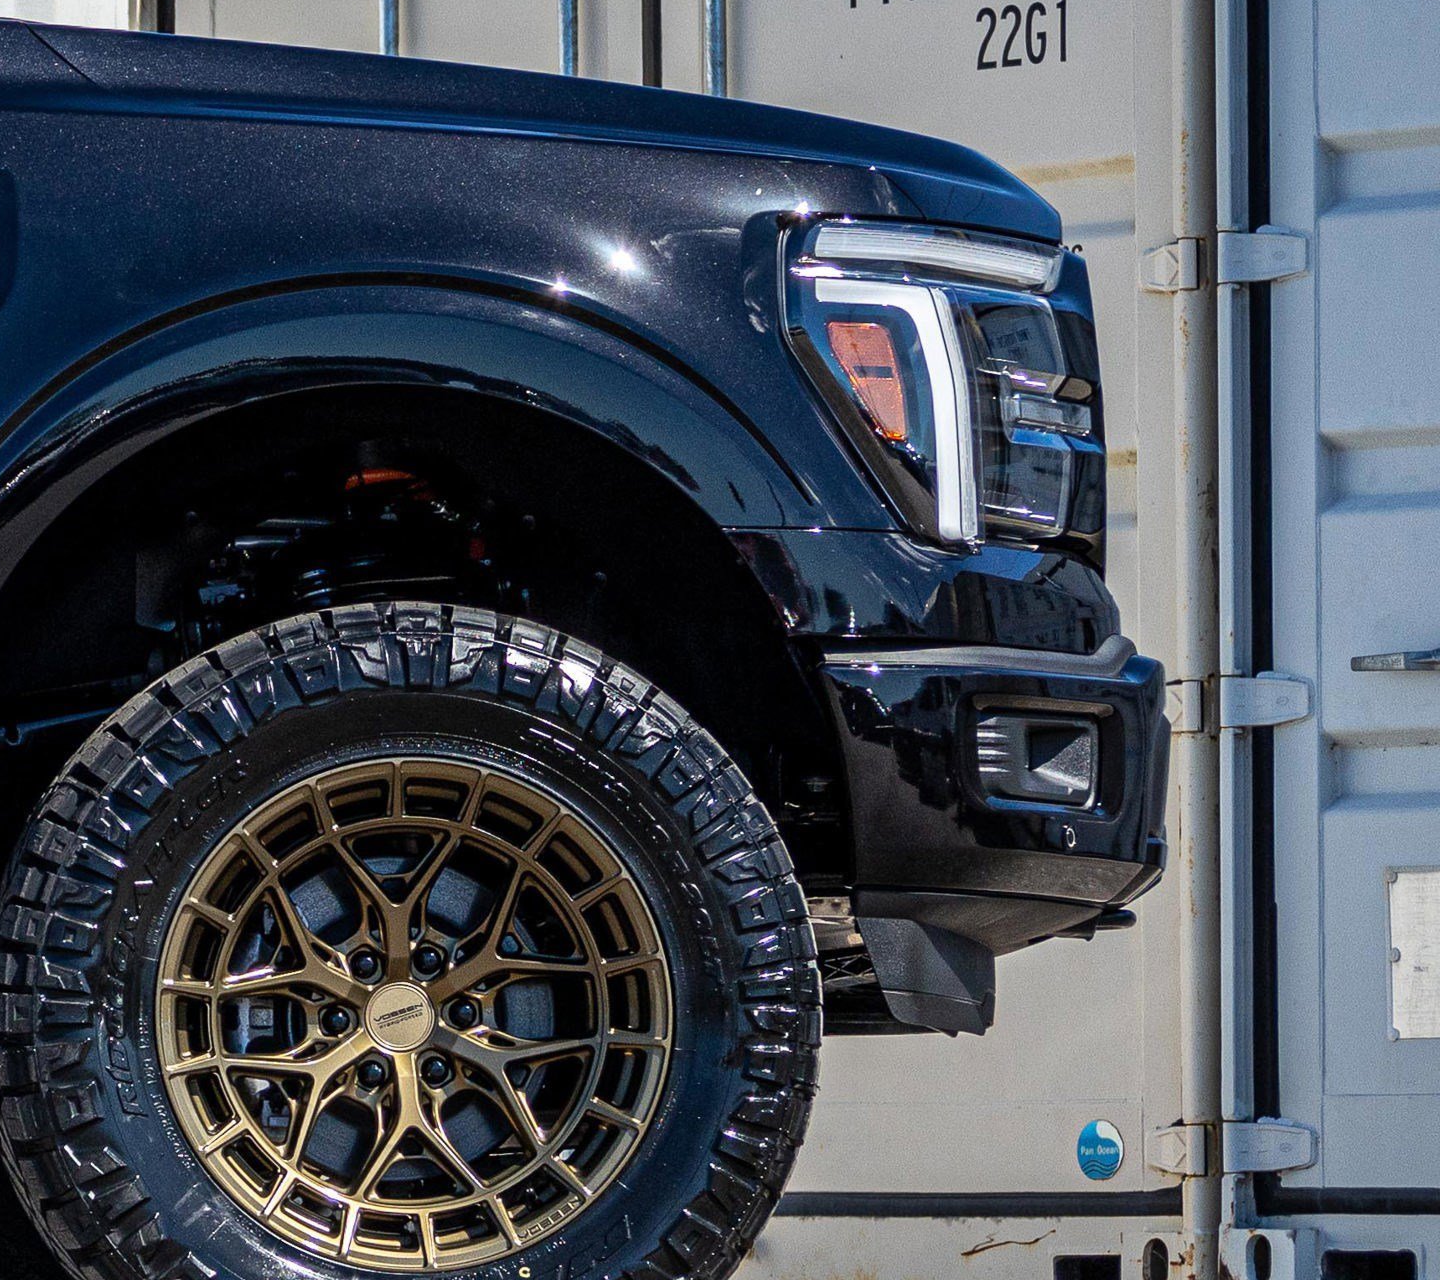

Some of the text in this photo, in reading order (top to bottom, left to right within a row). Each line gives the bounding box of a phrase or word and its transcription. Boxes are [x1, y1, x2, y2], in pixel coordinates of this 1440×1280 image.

[976, 0, 1068, 70] 22G1
[373, 1002, 424, 1023] VOSSEN
[517, 1195, 582, 1240] VOSSEN
